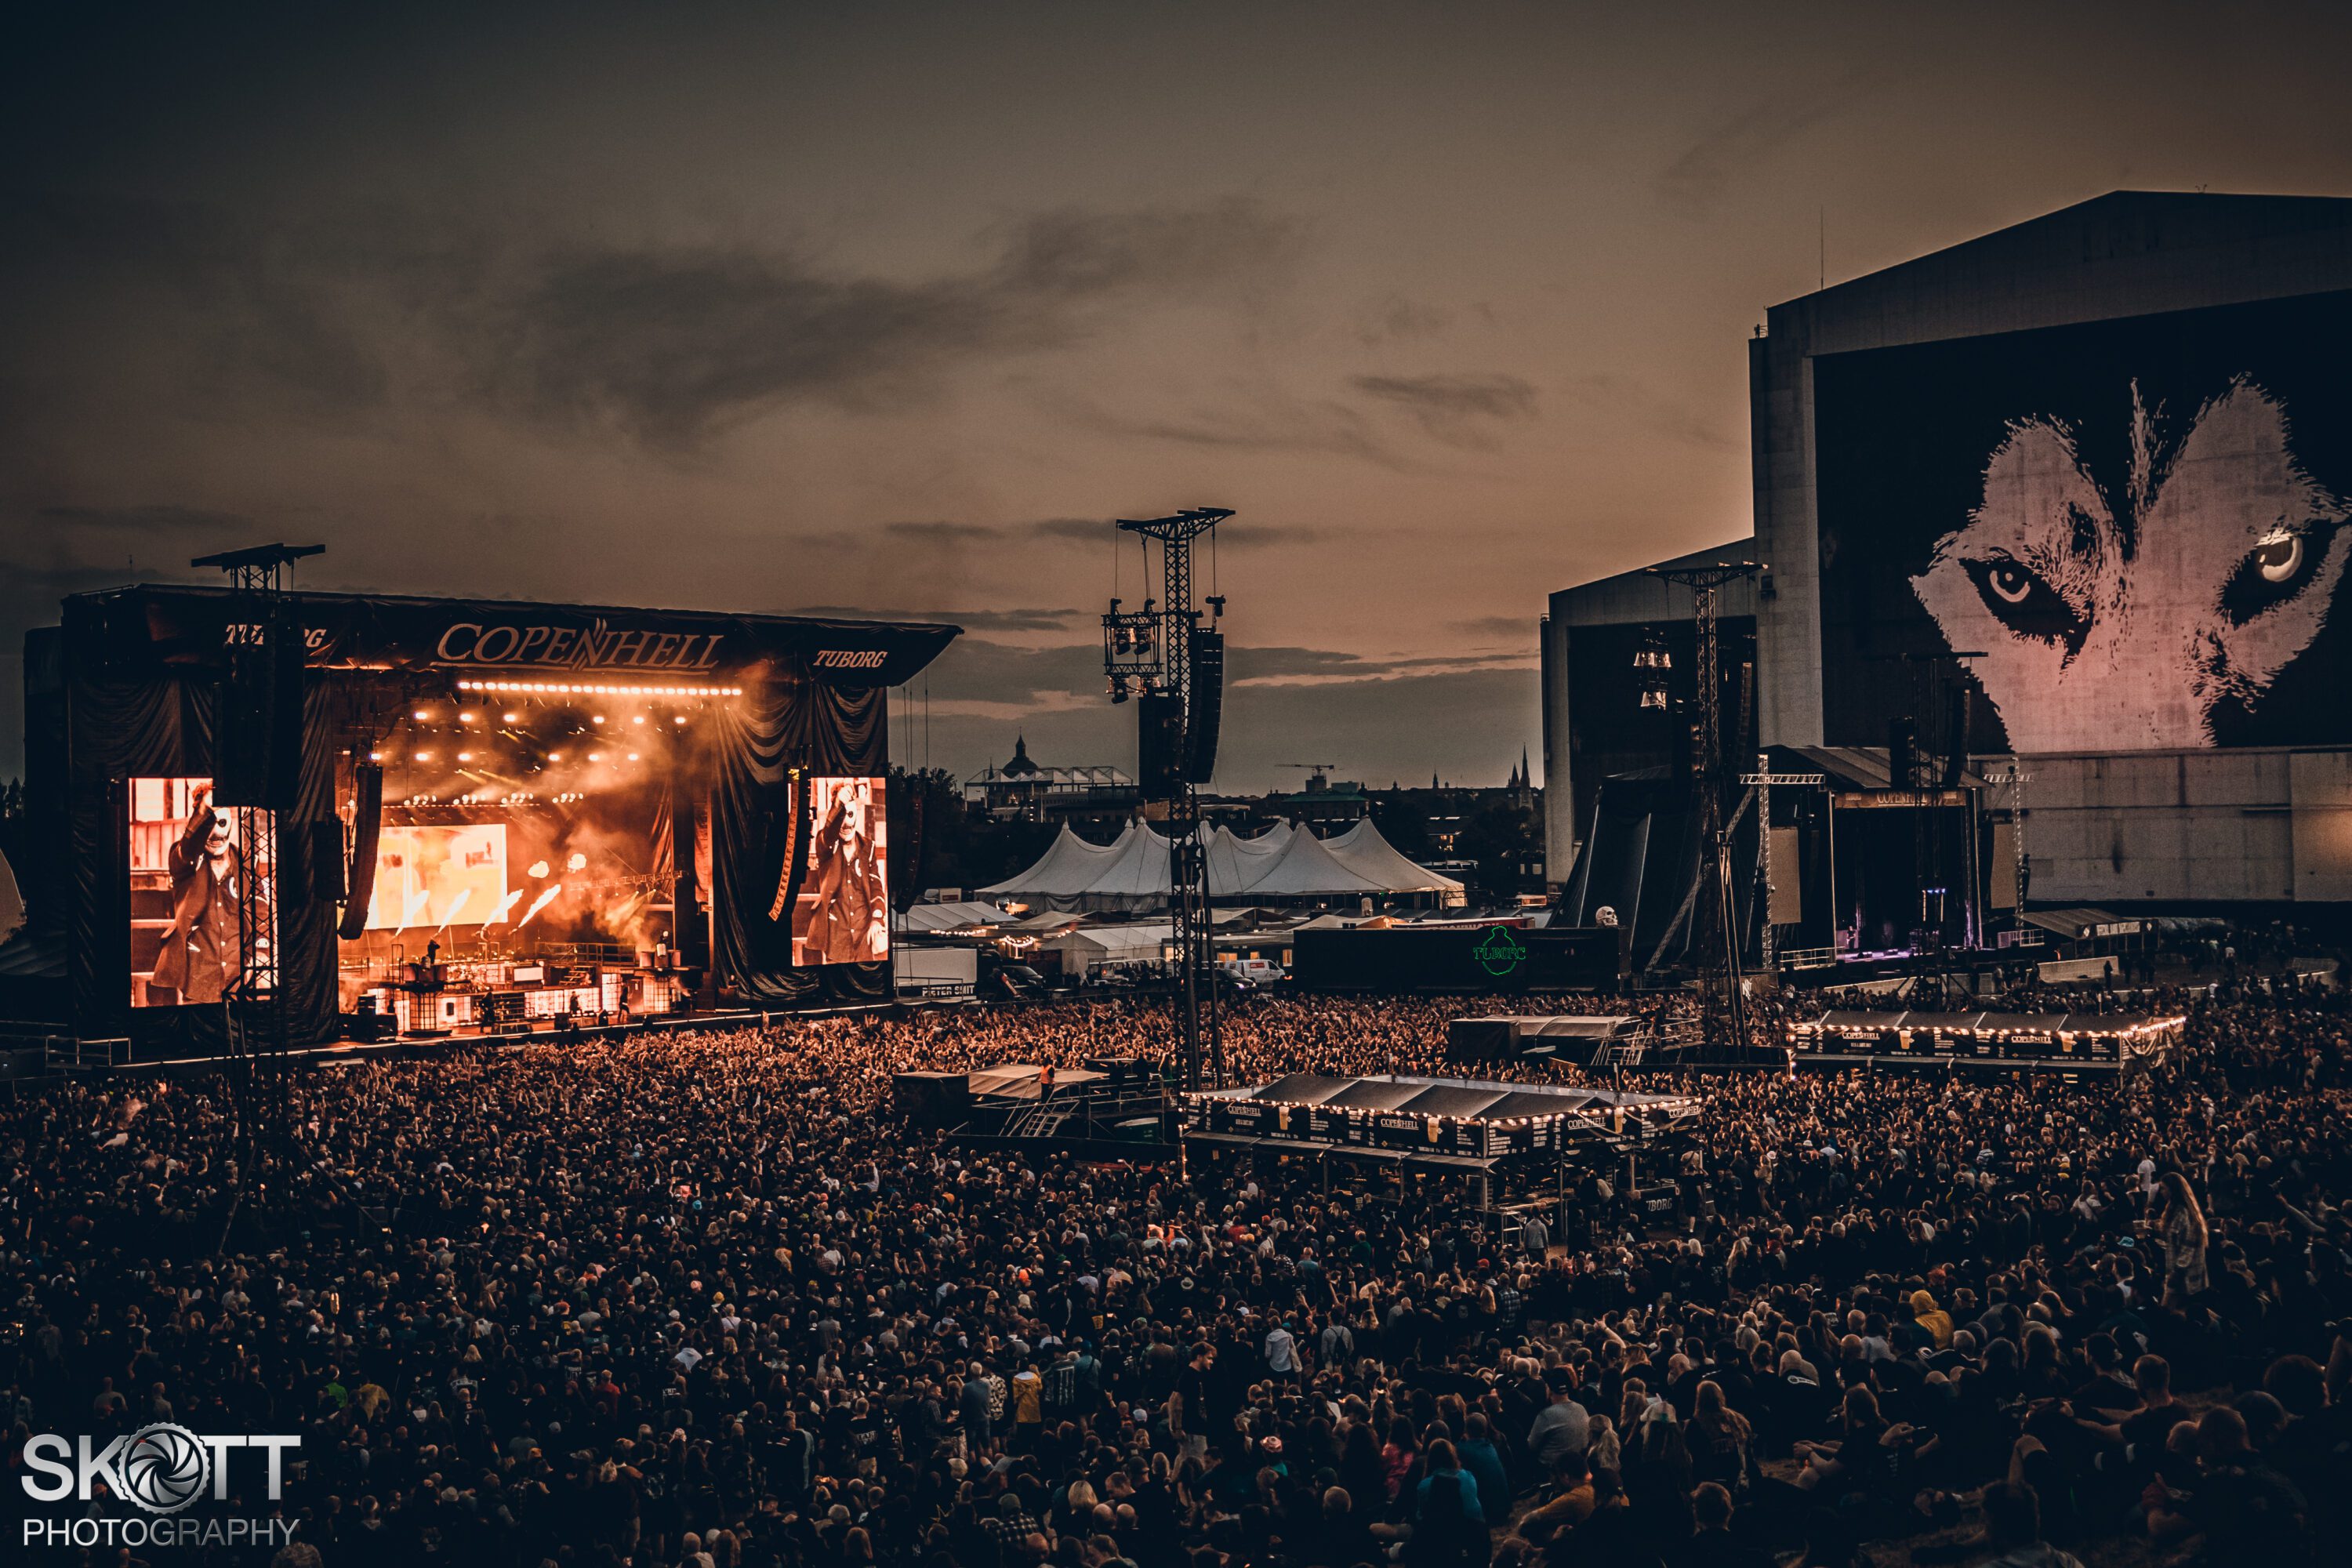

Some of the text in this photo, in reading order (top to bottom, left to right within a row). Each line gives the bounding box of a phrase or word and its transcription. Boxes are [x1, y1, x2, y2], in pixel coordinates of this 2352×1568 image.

[434, 617, 724, 672] COPENHELL
[813, 650, 888, 668] TUBORG
[1473, 947, 1526, 960] TUBORG
